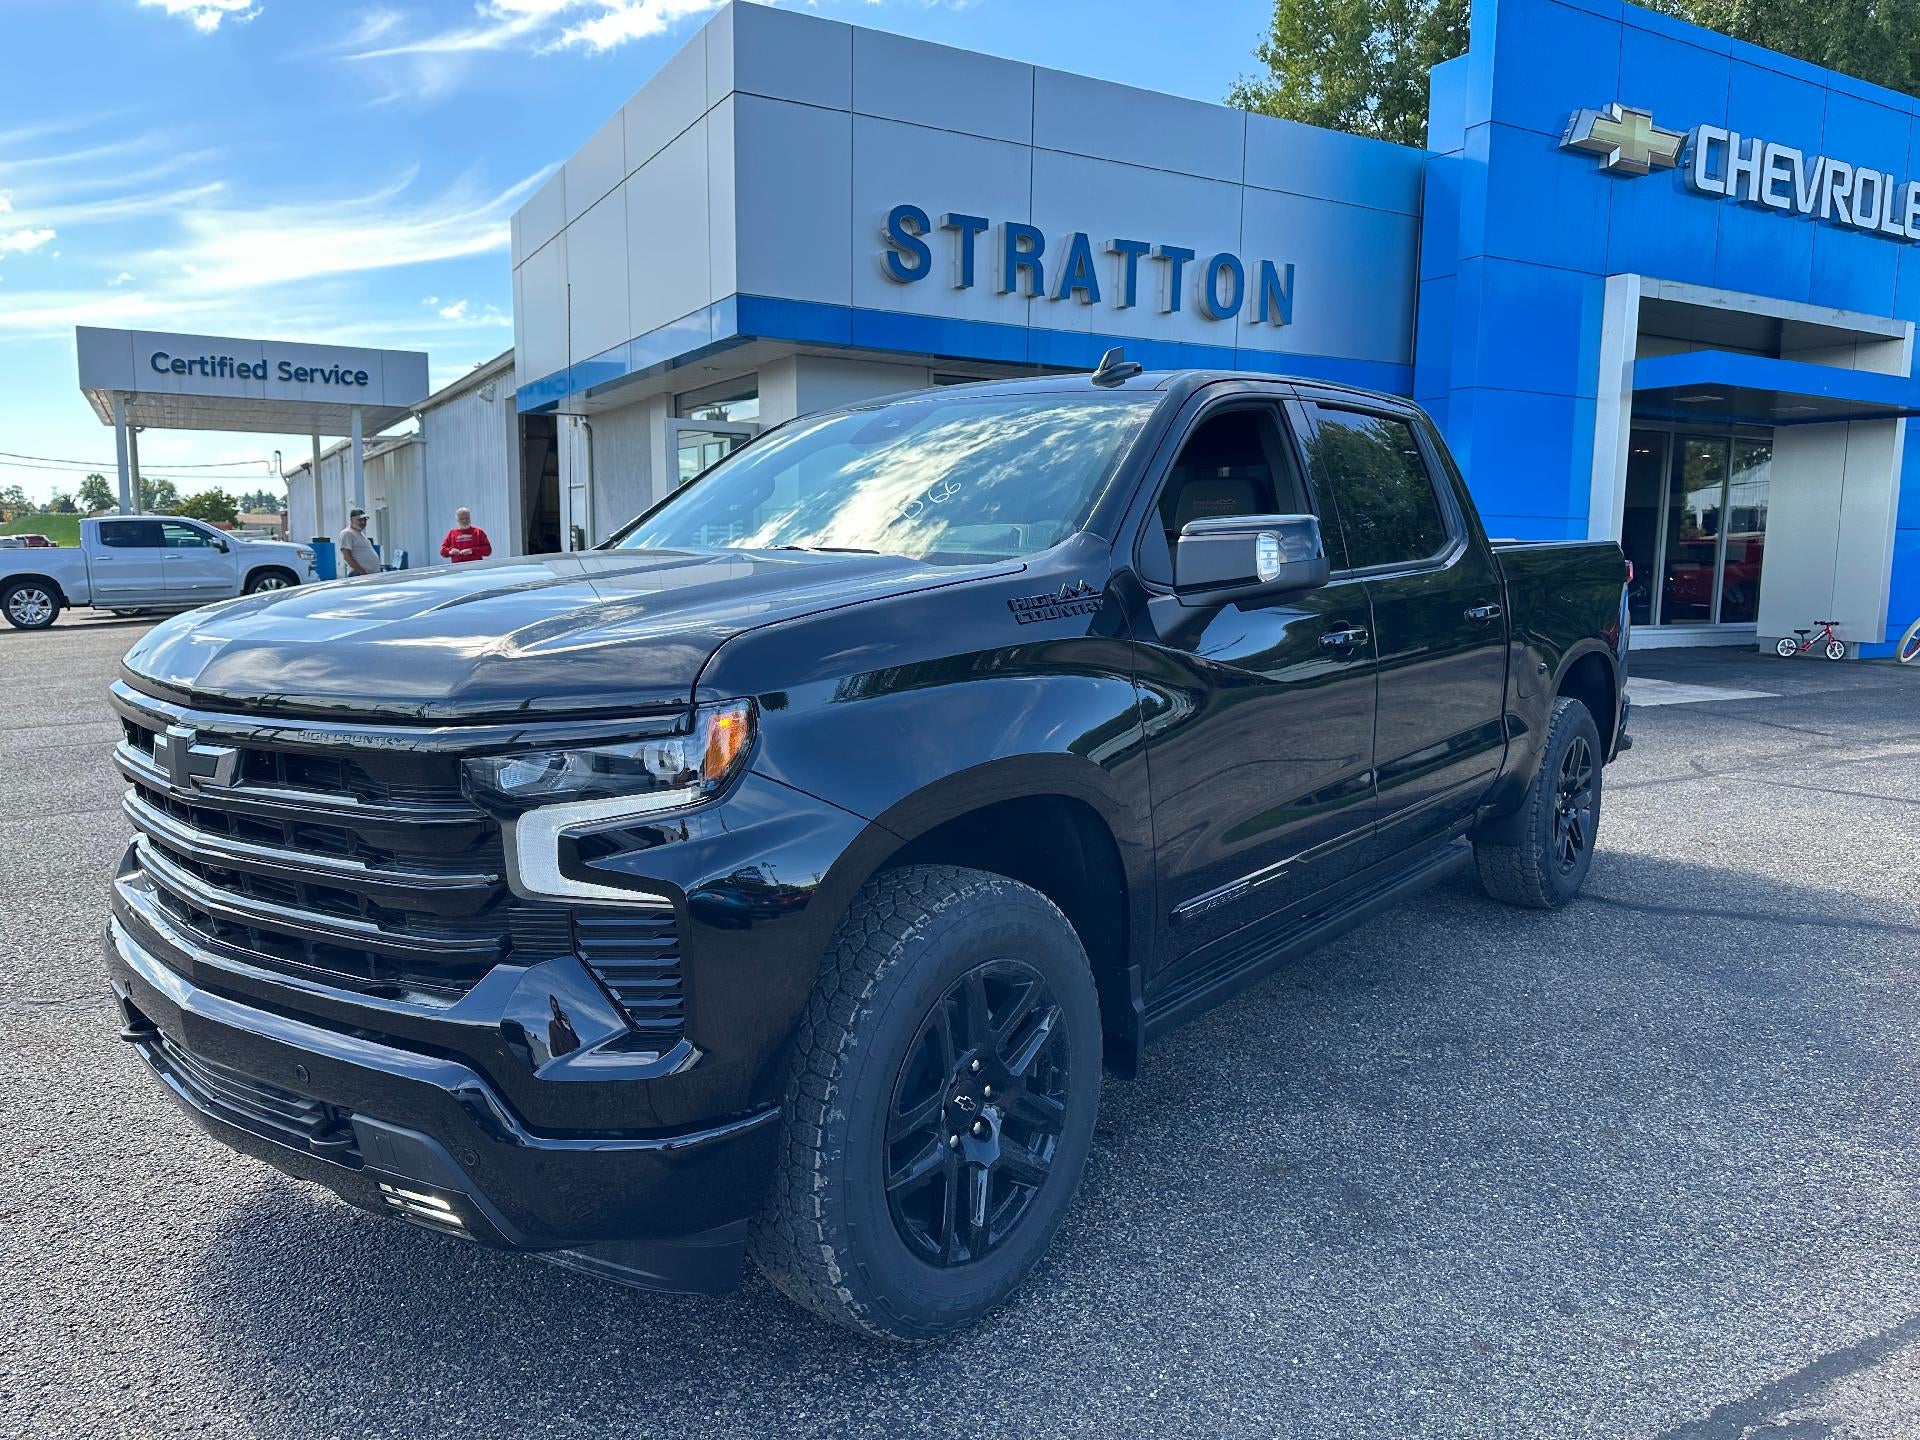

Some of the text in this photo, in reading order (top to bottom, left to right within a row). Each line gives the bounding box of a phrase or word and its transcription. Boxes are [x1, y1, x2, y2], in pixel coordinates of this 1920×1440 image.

[880, 204, 1296, 327] STRATTON
[150, 351, 369, 386] Certified Service
[1007, 592, 1061, 613] HIGH
[298, 730, 405, 746] HIGH COUNTRY
